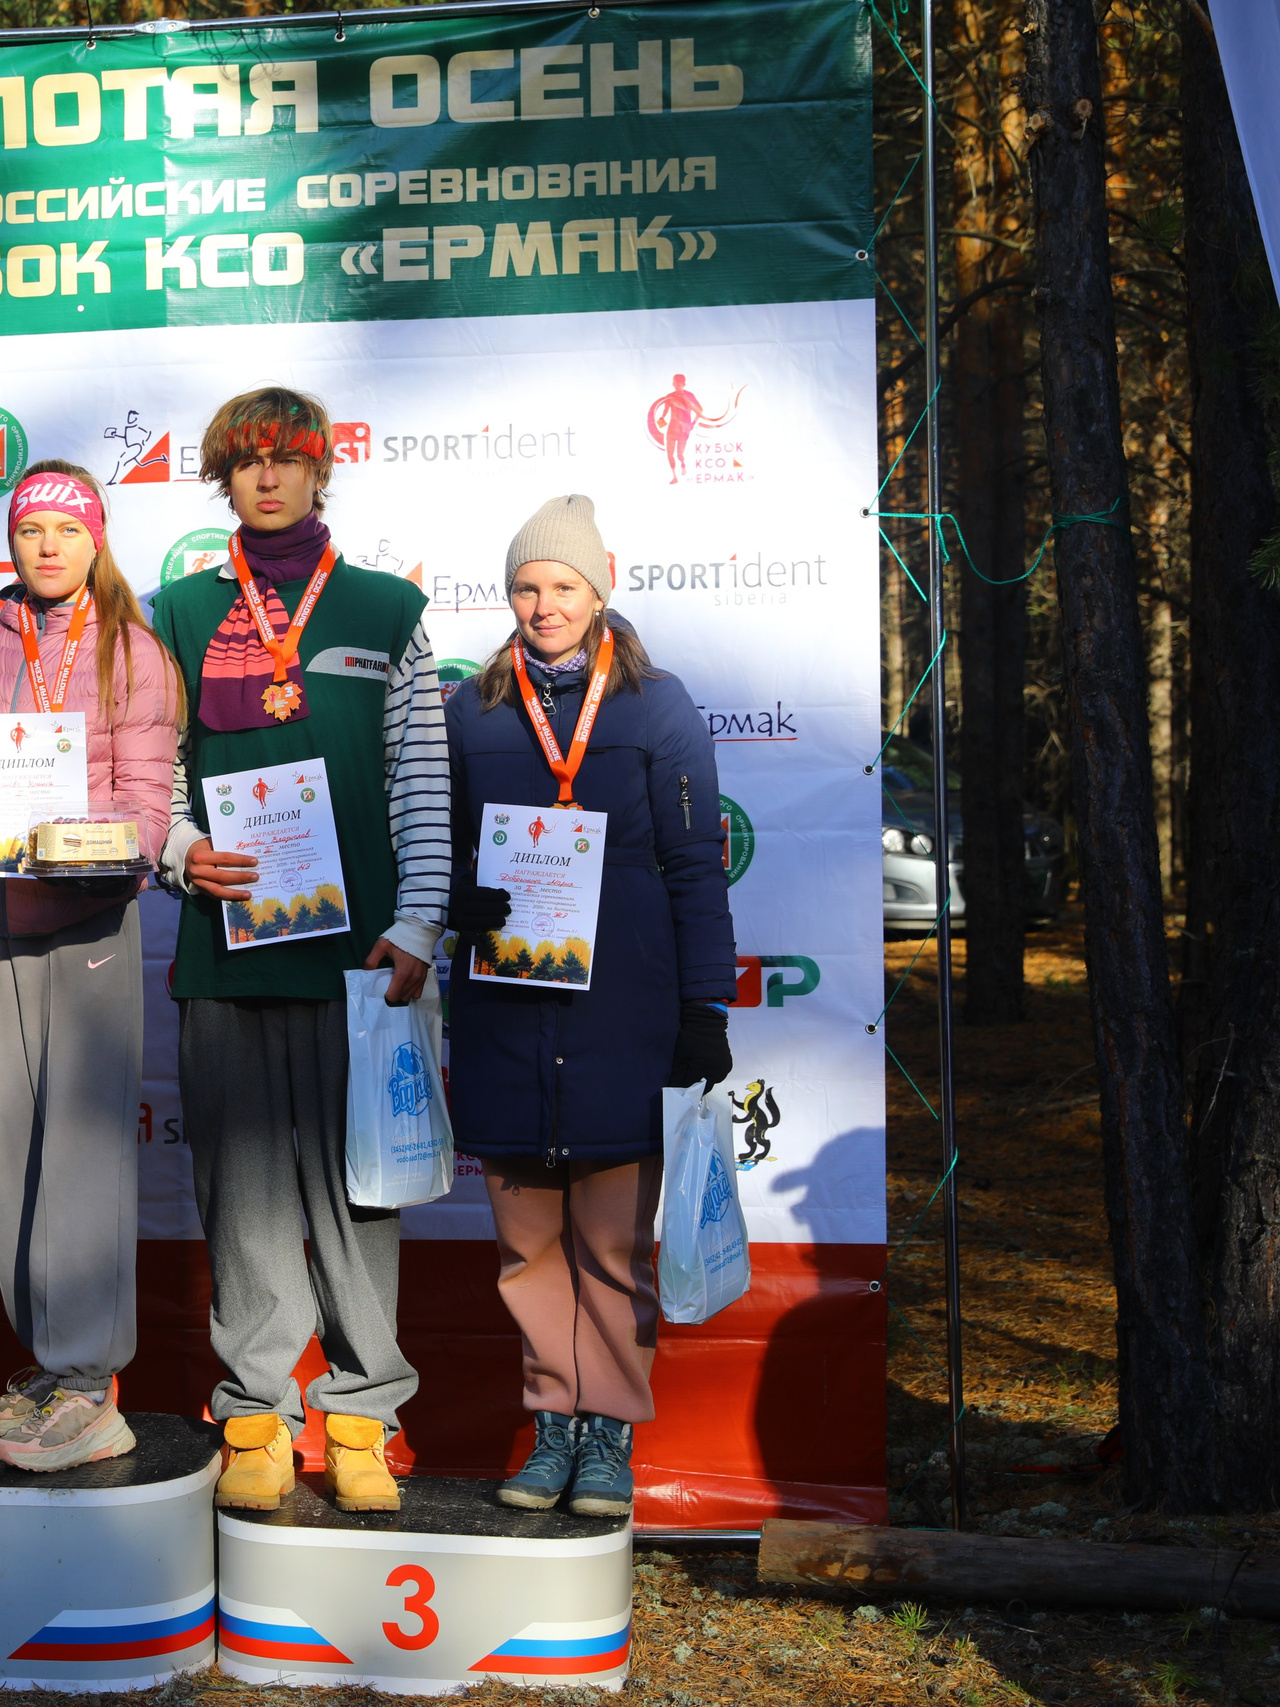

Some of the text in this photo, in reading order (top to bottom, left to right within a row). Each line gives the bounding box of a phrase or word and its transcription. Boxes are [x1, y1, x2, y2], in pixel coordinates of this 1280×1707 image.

[369, 37, 744, 129] ОСЕНЬ
[296, 155, 717, 210] СОРЕВНОВАНИЯ
[144, 231, 305, 291] КСО
[340, 215, 717, 282] «ЕРМАК»
[695, 442, 744, 454] КУБОК
[695, 457, 726, 469] КСО
[165, 541, 189, 581] ФЕДЕРАЦИЯ
[628, 551, 828, 593] SPORTident
[249, 580, 275, 641] ЗОЛОТАЯ ОСЕНЬ
[297, 571, 328, 627] ЗОЛОТАЯ ОСЕНЬ
[713, 590, 787, 607] siberia
[33, 658, 44, 684] ОСЕНЬ
[56, 640, 78, 704] ЗОЛОТАЯ ОСЕНЬ
[284, 686, 294, 698] 3
[580, 673, 606, 742] ЗОЛОТАЯ ОСЕНЬ
[531, 696, 562, 762] ЗОЛОТАЯ ОСЕНЬ
[697, 701, 797, 738] рмак
[243, 809, 302, 830] ДИПЛОМ
[250, 826, 300, 839] НАГРАЖДАЕТСЯ
[509, 852, 572, 867] ДИПЛОМ
[728, 814, 750, 879] ОРИЕНТИРОВАНИЯ
[514, 868, 566, 879] НАГРАЖДАЕТСЯ
[381, 1563, 441, 1652] 3
